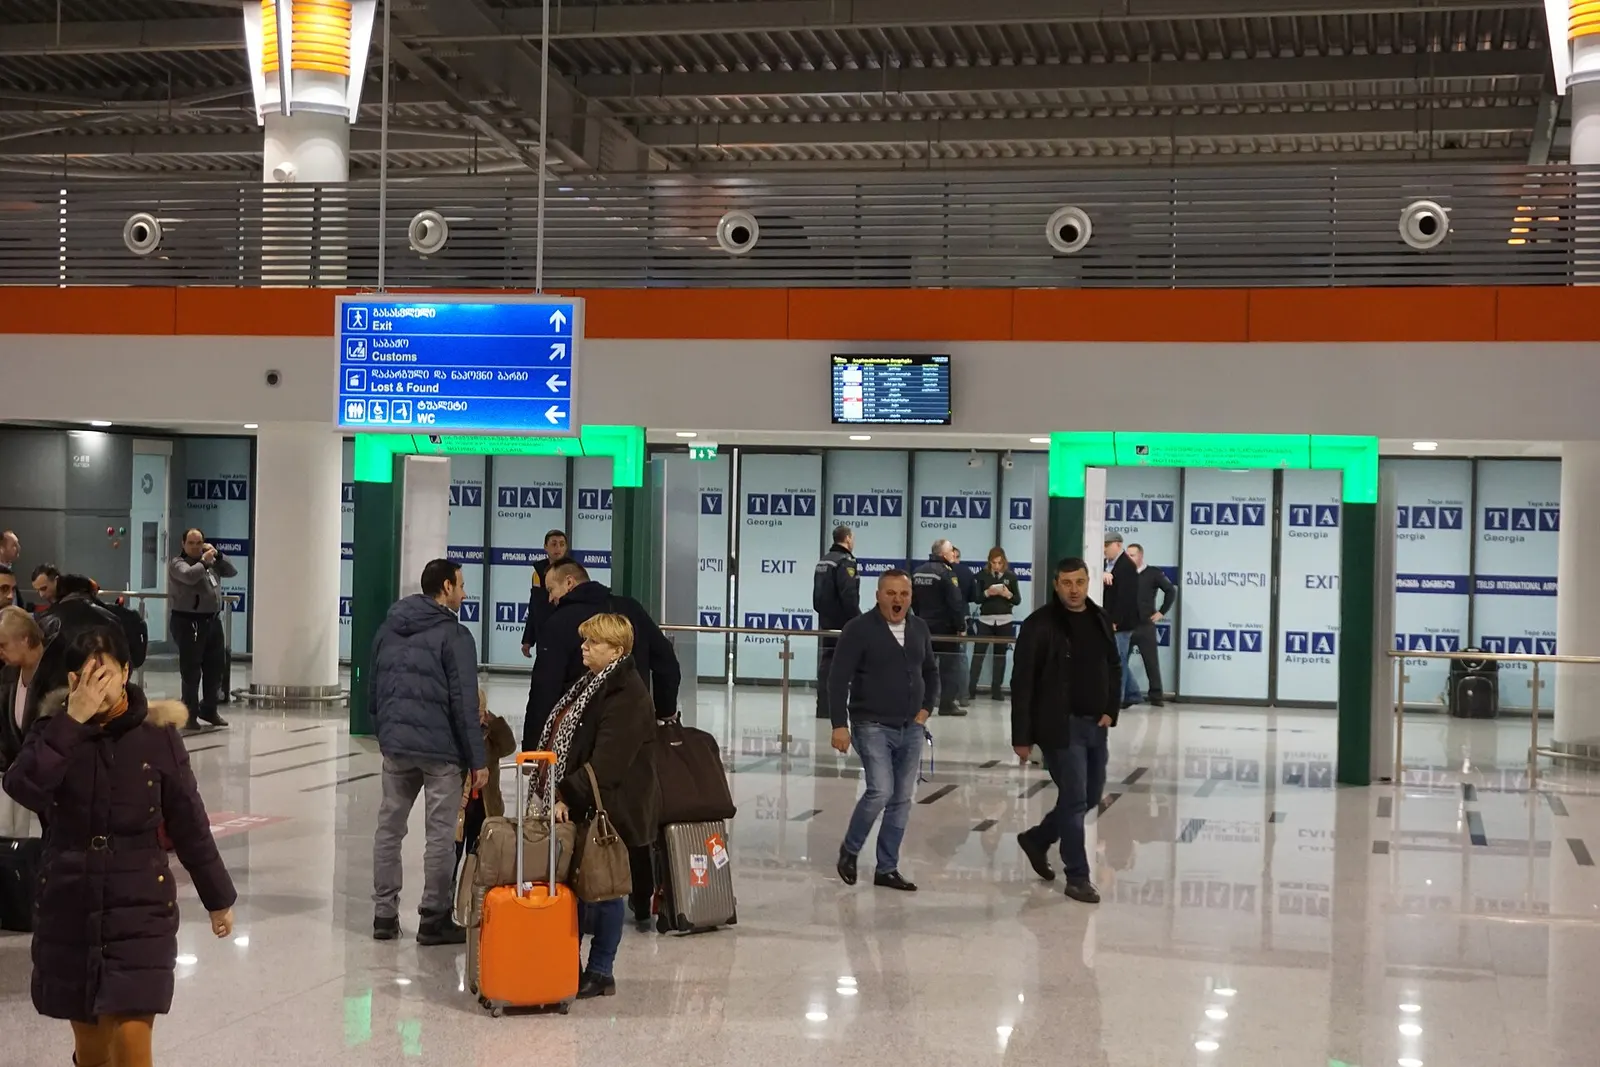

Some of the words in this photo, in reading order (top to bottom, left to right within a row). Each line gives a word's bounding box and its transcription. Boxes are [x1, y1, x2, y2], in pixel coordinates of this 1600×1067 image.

[373, 322, 392, 331] Exit
[373, 338, 409, 348] საბაჟო
[372, 352, 417, 362] Customs
[372, 369, 430, 380] დაკარგული
[434, 370, 446, 380] და
[498, 372, 528, 382] ბარგი
[371, 383, 393, 392] Lost
[396, 384, 404, 392] &
[406, 383, 439, 392] Found
[418, 400, 468, 412] ტუალეტი
[418, 414, 436, 424] WC
[188, 481, 245, 499] TAV
[500, 490, 560, 508] TAV
[750, 496, 813, 514] TAV
[836, 498, 898, 515] TAV
[924, 500, 988, 517] TAV
[498, 511, 532, 520] Georgia
[1106, 503, 1172, 520] TAV
[1194, 506, 1262, 524] TAV
[746, 518, 782, 527] Georgia
[832, 518, 868, 528] Georgia
[920, 520, 958, 530] Georgia
[1488, 510, 1560, 530] TAV
[1190, 528, 1230, 538] Georgia
[1288, 530, 1328, 540] Georgia
[1484, 534, 1525, 543] Georgia
[584, 556, 608, 564] ARRIVAL
[762, 560, 797, 574] EXIT
[1186, 571, 1266, 588] გასასვლელი
[1496, 580, 1542, 590] INTERNATIONAL
[744, 635, 784, 644] Airports
[1191, 632, 1258, 650] TAV
[1187, 652, 1232, 662] Airports
[1285, 656, 1331, 664] Airports
